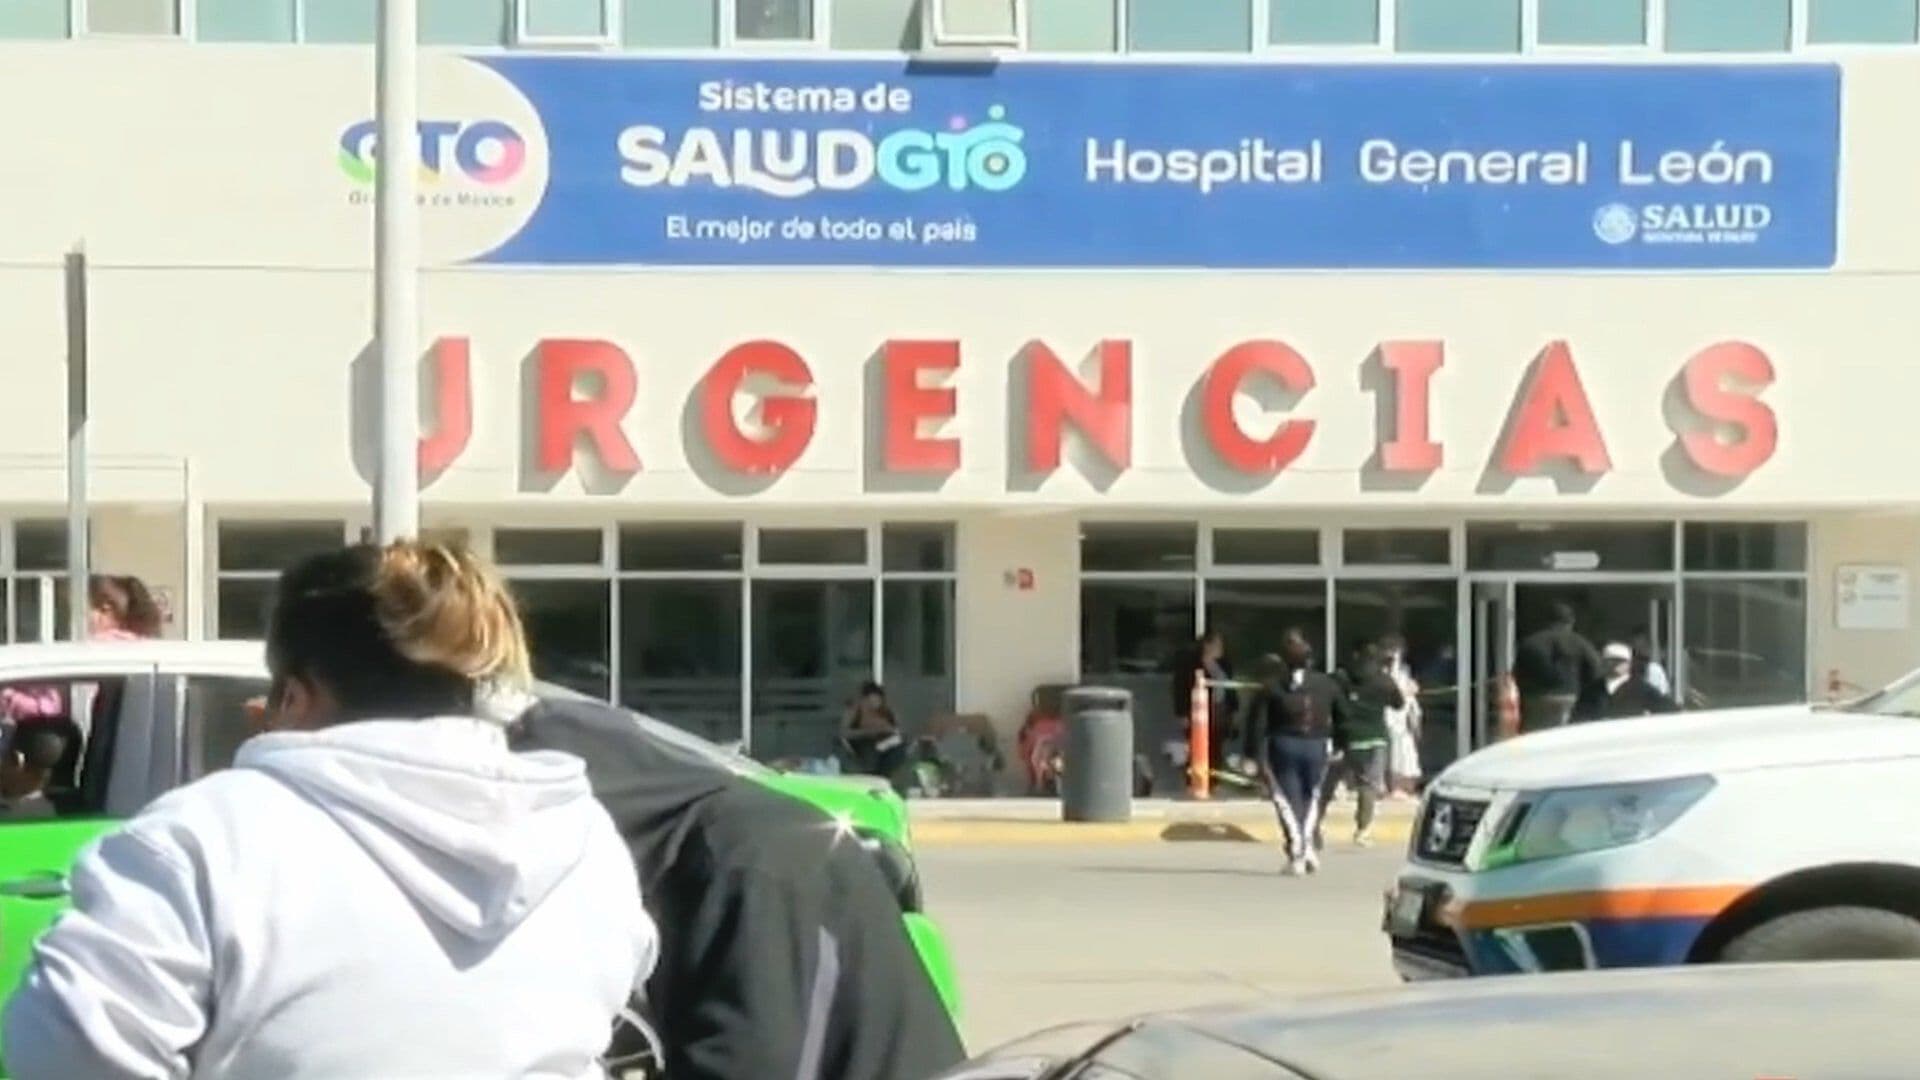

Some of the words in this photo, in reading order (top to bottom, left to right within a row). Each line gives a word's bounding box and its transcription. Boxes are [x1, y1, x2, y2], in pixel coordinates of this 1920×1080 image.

[699, 81, 855, 112] Sistema
[862, 82, 912, 112] de
[1085, 137, 1322, 195] Hospital
[1359, 139, 1588, 184] General
[1619, 139, 1773, 185] León
[666, 216, 688, 238] El
[696, 215, 773, 244] mejor
[780, 216, 816, 240] de
[820, 216, 881, 240] todo
[888, 217, 915, 241] el
[1641, 204, 1772, 230] SALUD
[383, 336, 1780, 477] URGENCIAS
